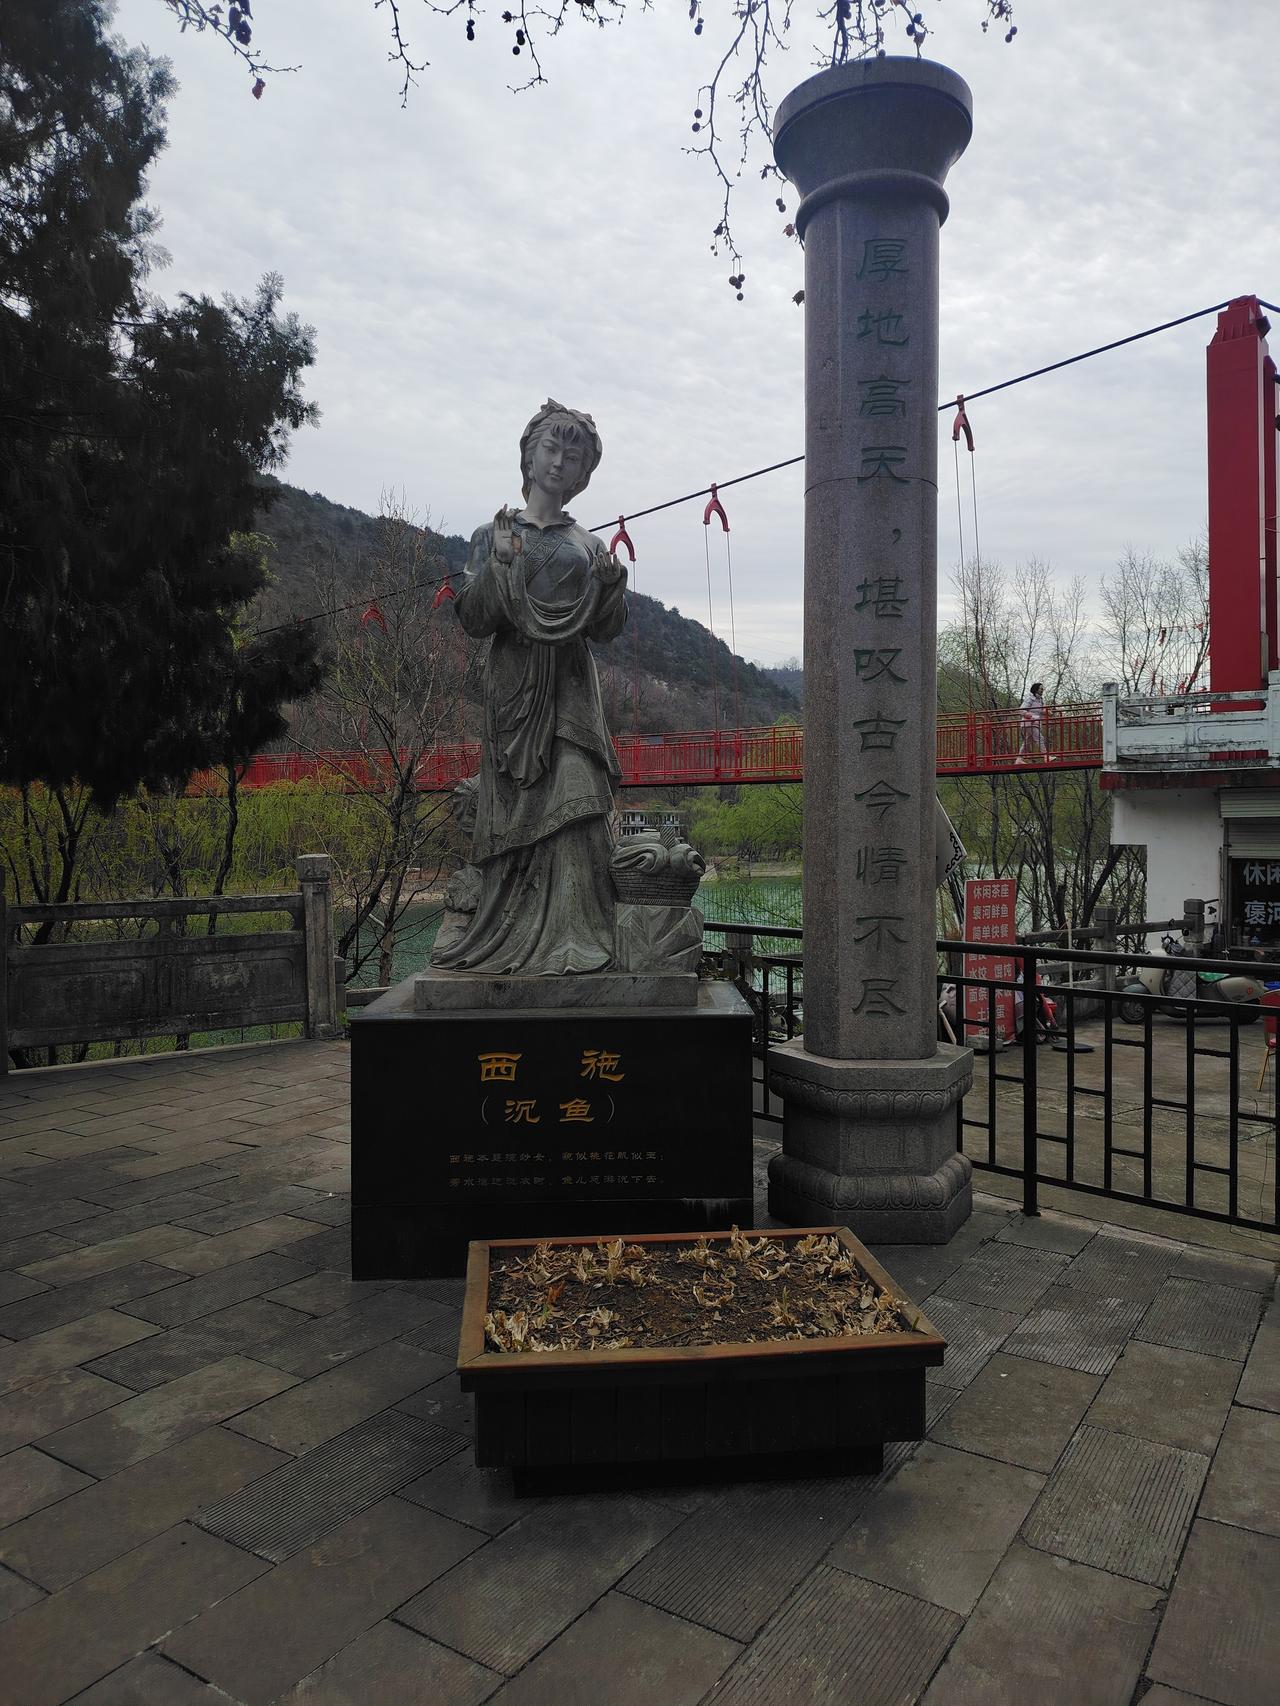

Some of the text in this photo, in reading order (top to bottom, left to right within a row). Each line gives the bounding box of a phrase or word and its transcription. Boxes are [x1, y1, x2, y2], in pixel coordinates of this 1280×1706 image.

[973, 884, 1009, 899] 休闲茶座
[973, 904, 1009, 920] 褒河鲜鱼
[972, 924, 1009, 941] 简单快餐
[478, 1049, 625, 1083] 西施
